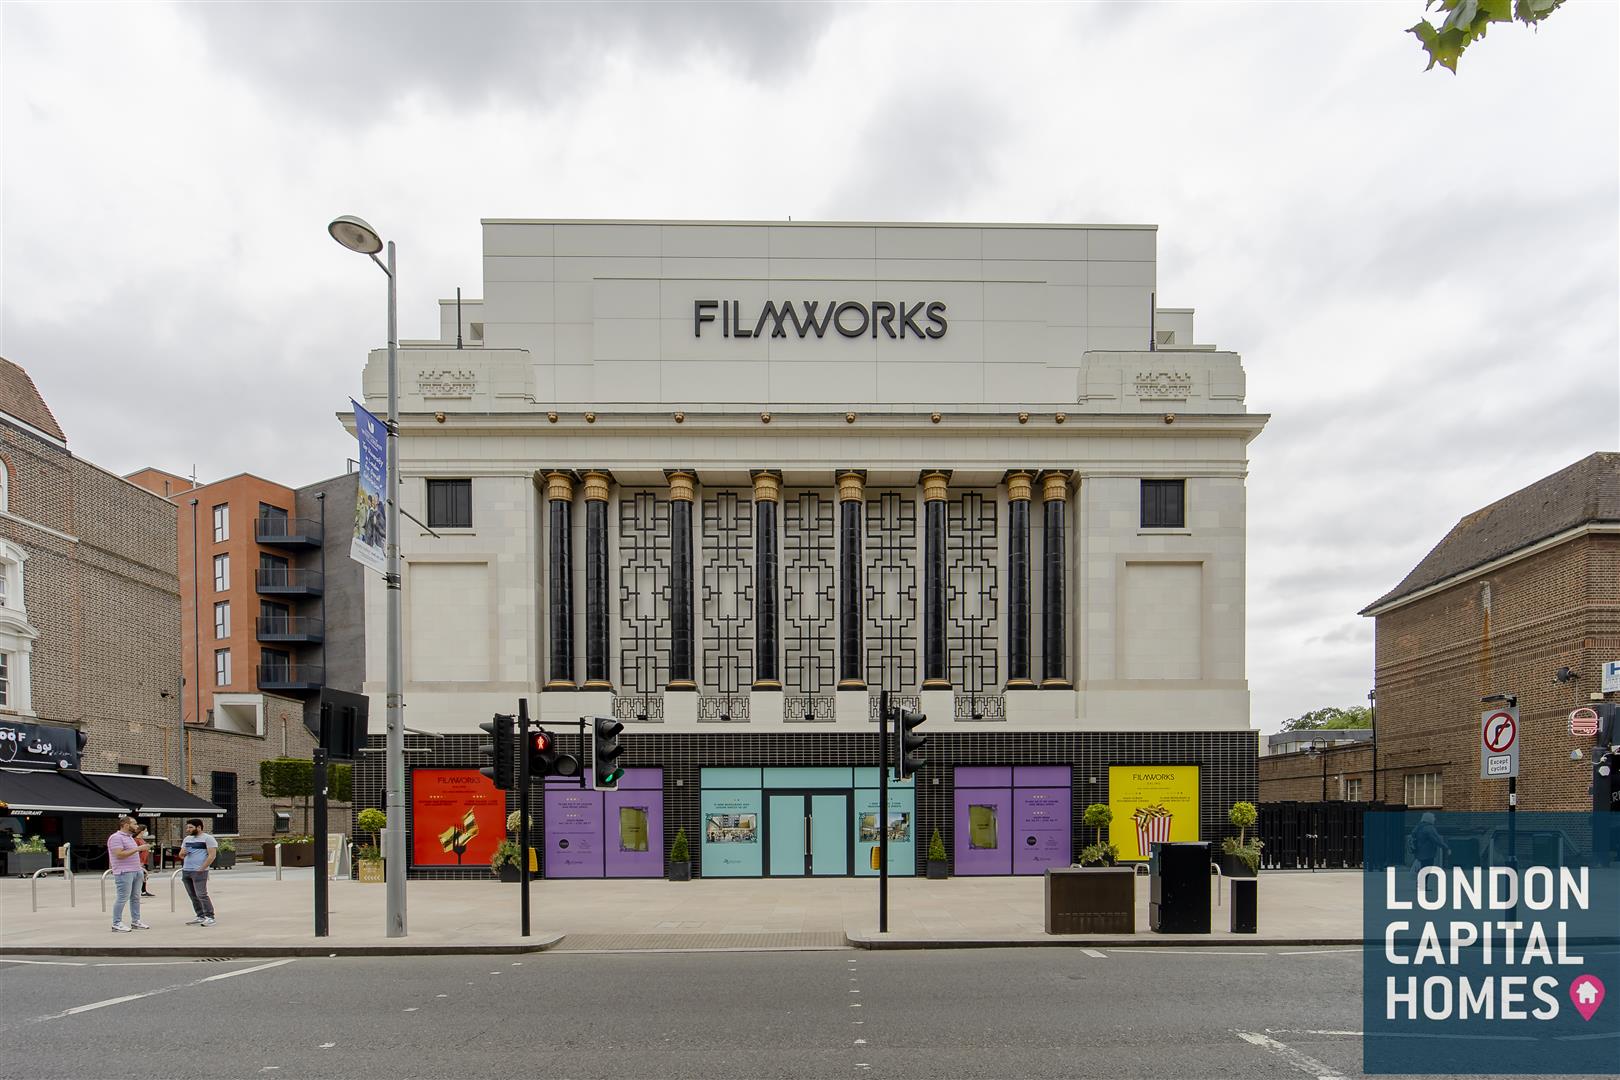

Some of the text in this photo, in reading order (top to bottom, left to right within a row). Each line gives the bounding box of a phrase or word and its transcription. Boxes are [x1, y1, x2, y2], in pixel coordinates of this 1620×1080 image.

[694, 300, 948, 339] FILMWORKS
[1490, 758, 1508, 766] Except
[1490, 765, 1508, 773] cycles
[1132, 773, 1175, 781] FILMWORKS
